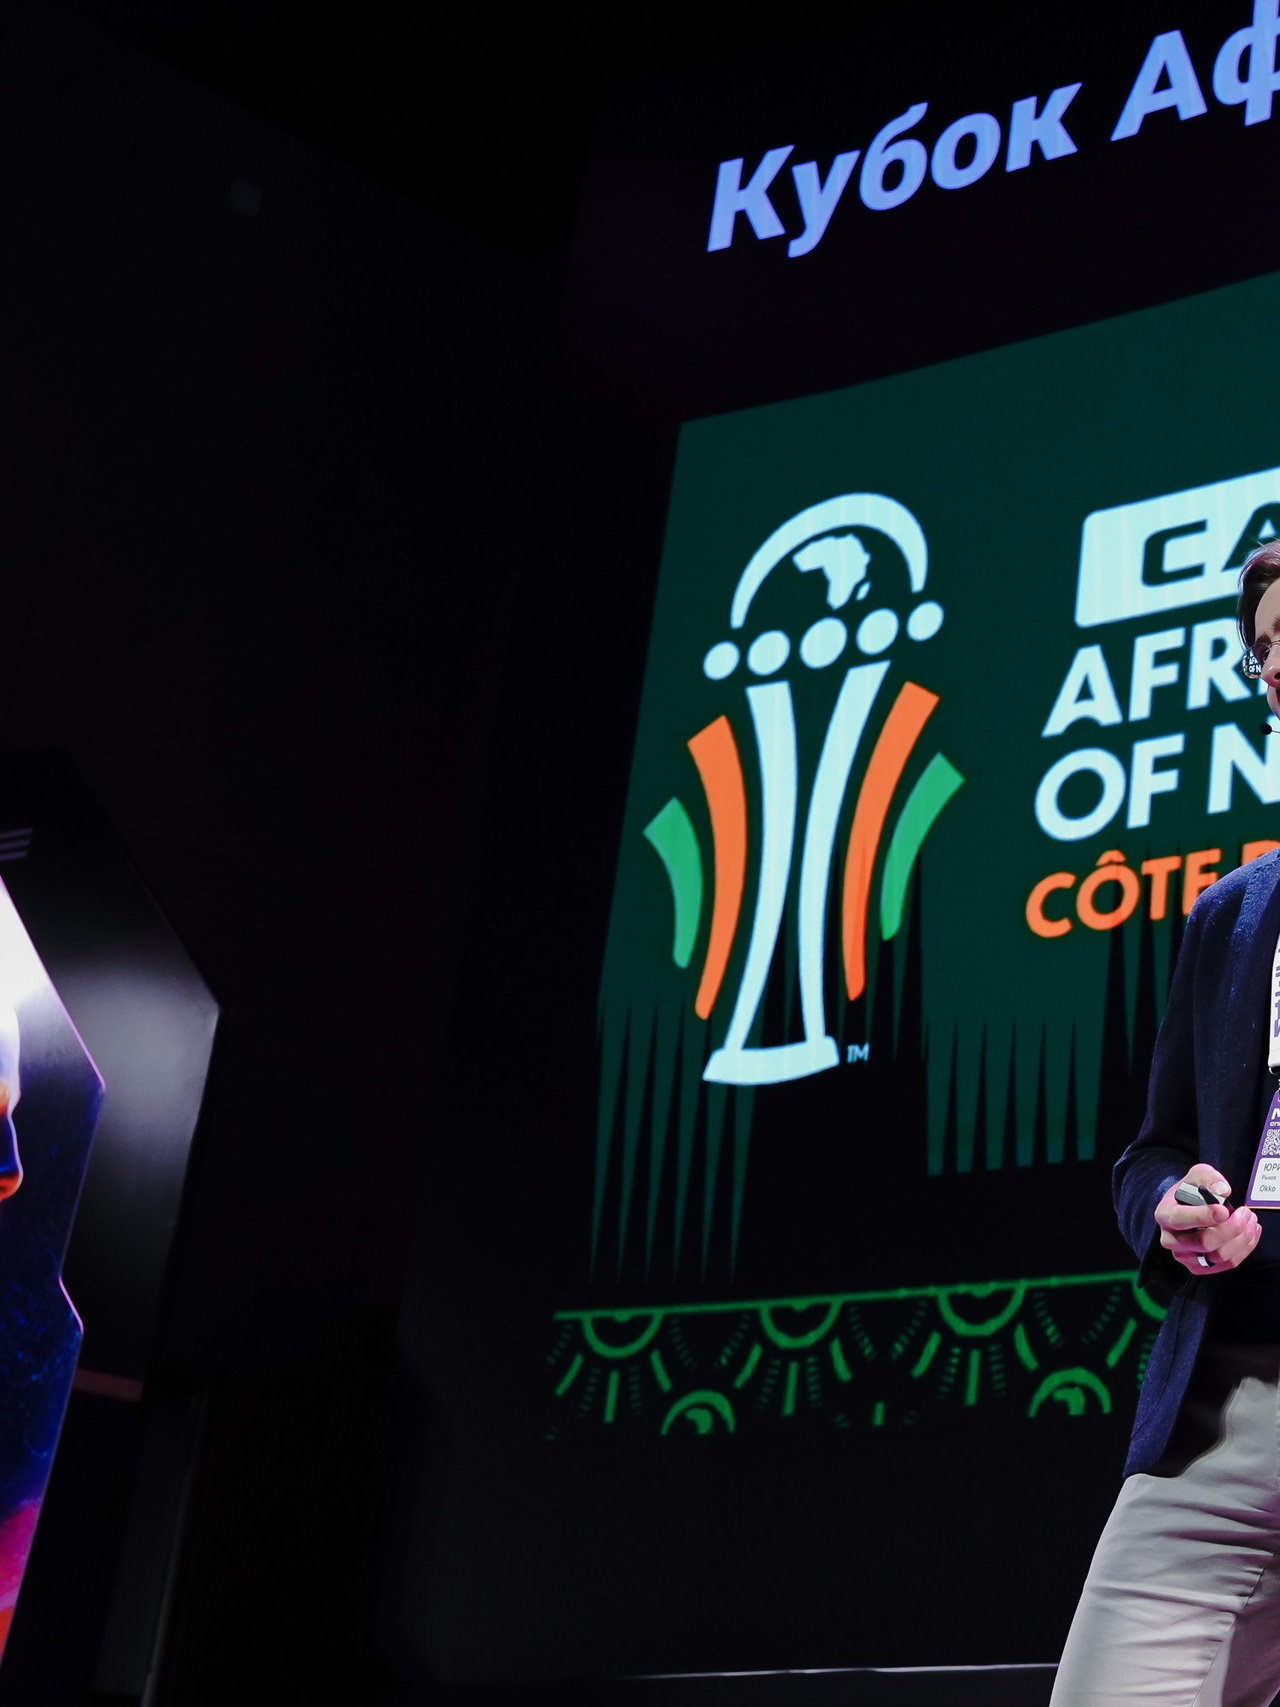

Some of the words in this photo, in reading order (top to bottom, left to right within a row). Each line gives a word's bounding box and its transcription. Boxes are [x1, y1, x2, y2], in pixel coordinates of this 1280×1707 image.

[708, 83, 1082, 258] Кубок
[1034, 732, 1186, 842] OF
[1025, 849, 1222, 938] CÔTE
[1259, 1184, 1276, 1193] Okko
